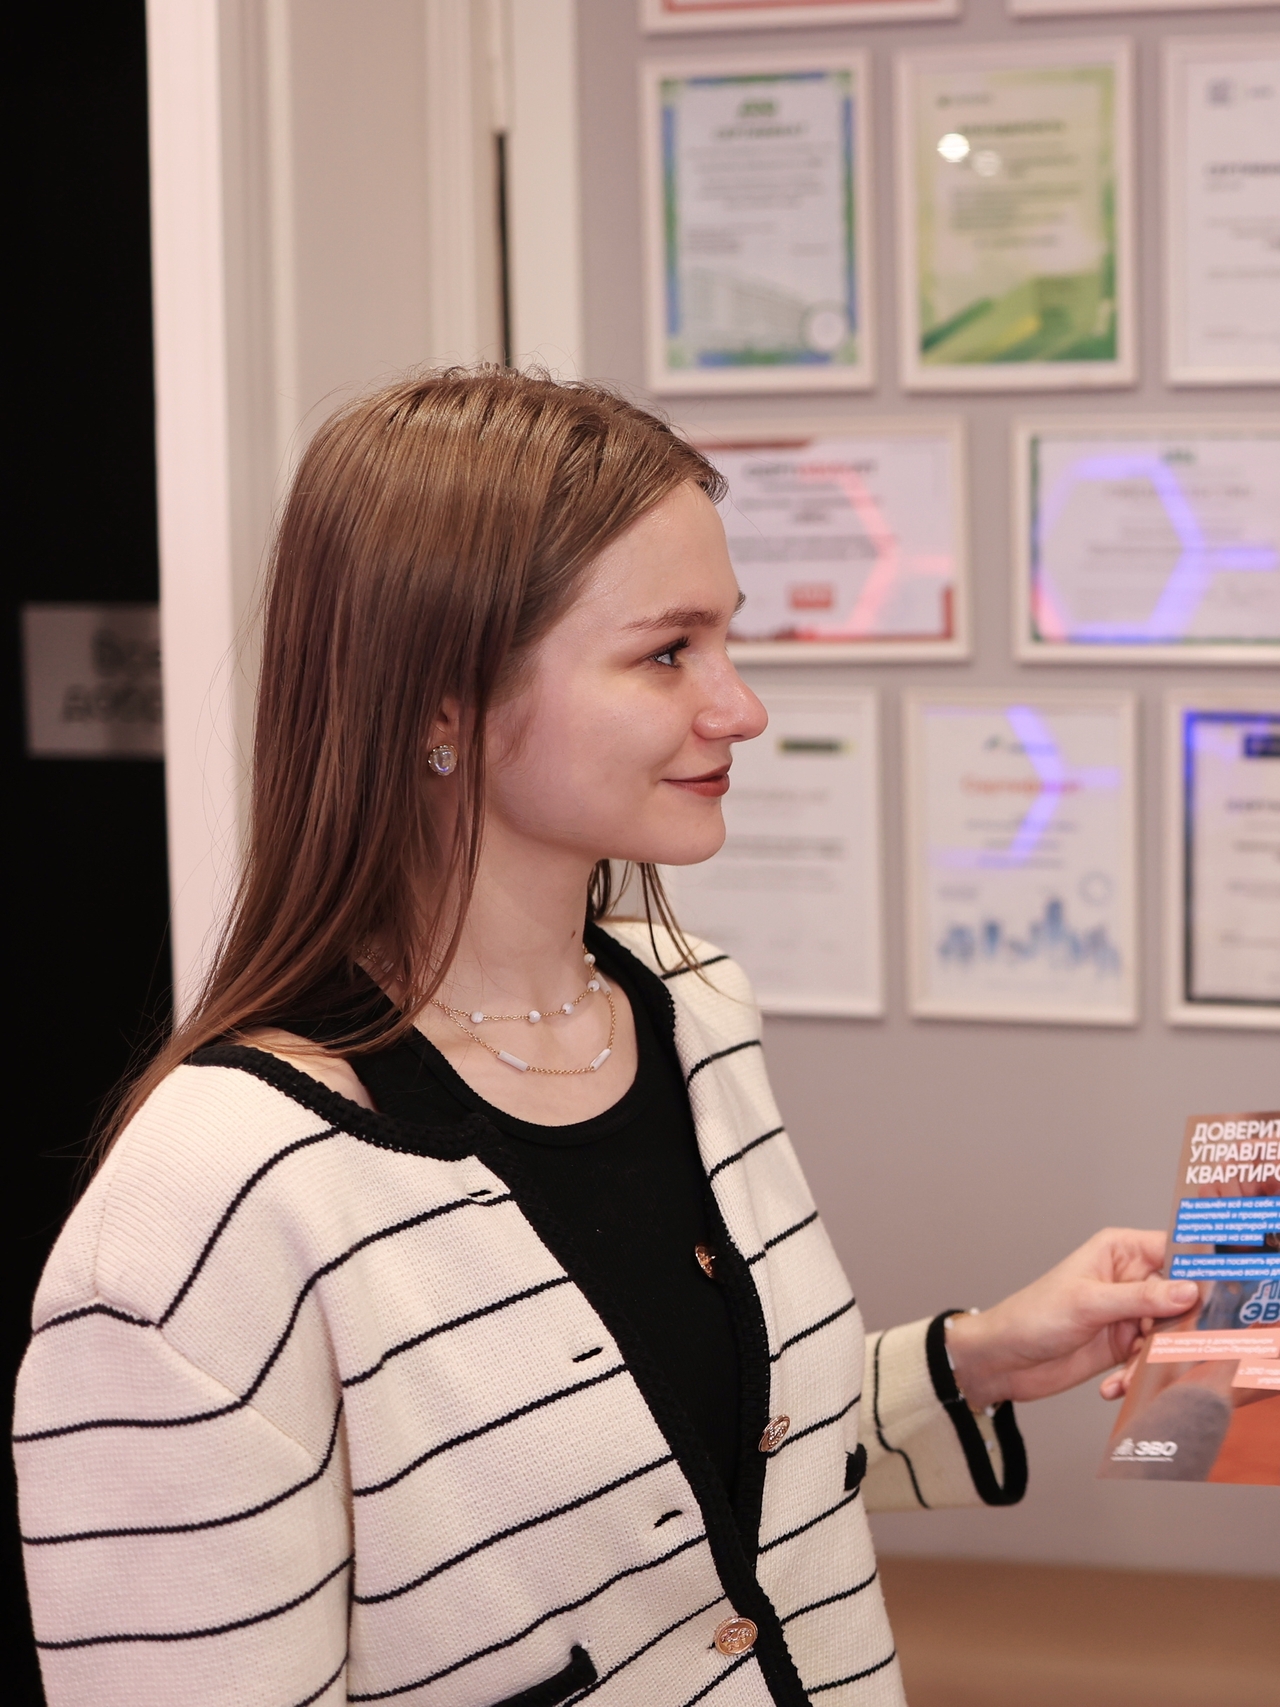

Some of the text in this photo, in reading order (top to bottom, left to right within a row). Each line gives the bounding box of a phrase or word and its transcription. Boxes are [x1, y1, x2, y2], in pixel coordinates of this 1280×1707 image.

[1181, 1200, 1193, 1209] Мы
[1227, 1199, 1241, 1208] всё
[1242, 1200, 1253, 1208] на
[1179, 1210, 1231, 1219] нанимателей
[1238, 1211, 1277, 1220] проверим
[1177, 1223, 1213, 1232] контроль
[1214, 1223, 1224, 1231] за
[1225, 1221, 1267, 1231] квартирой
[1176, 1233, 1200, 1243] будем
[1200, 1234, 1227, 1243] всегда
[1228, 1234, 1239, 1242] на
[1173, 1256, 1181, 1266] А
[1181, 1257, 1191, 1266] вы
[1192, 1257, 1225, 1266] сможете
[1226, 1257, 1265, 1266] посвятить
[1172, 1268, 1186, 1277] что
[1187, 1267, 1243, 1278] действительно
[1244, 1268, 1270, 1277] важно
[1134, 1440, 1178, 1457] ЭВО
